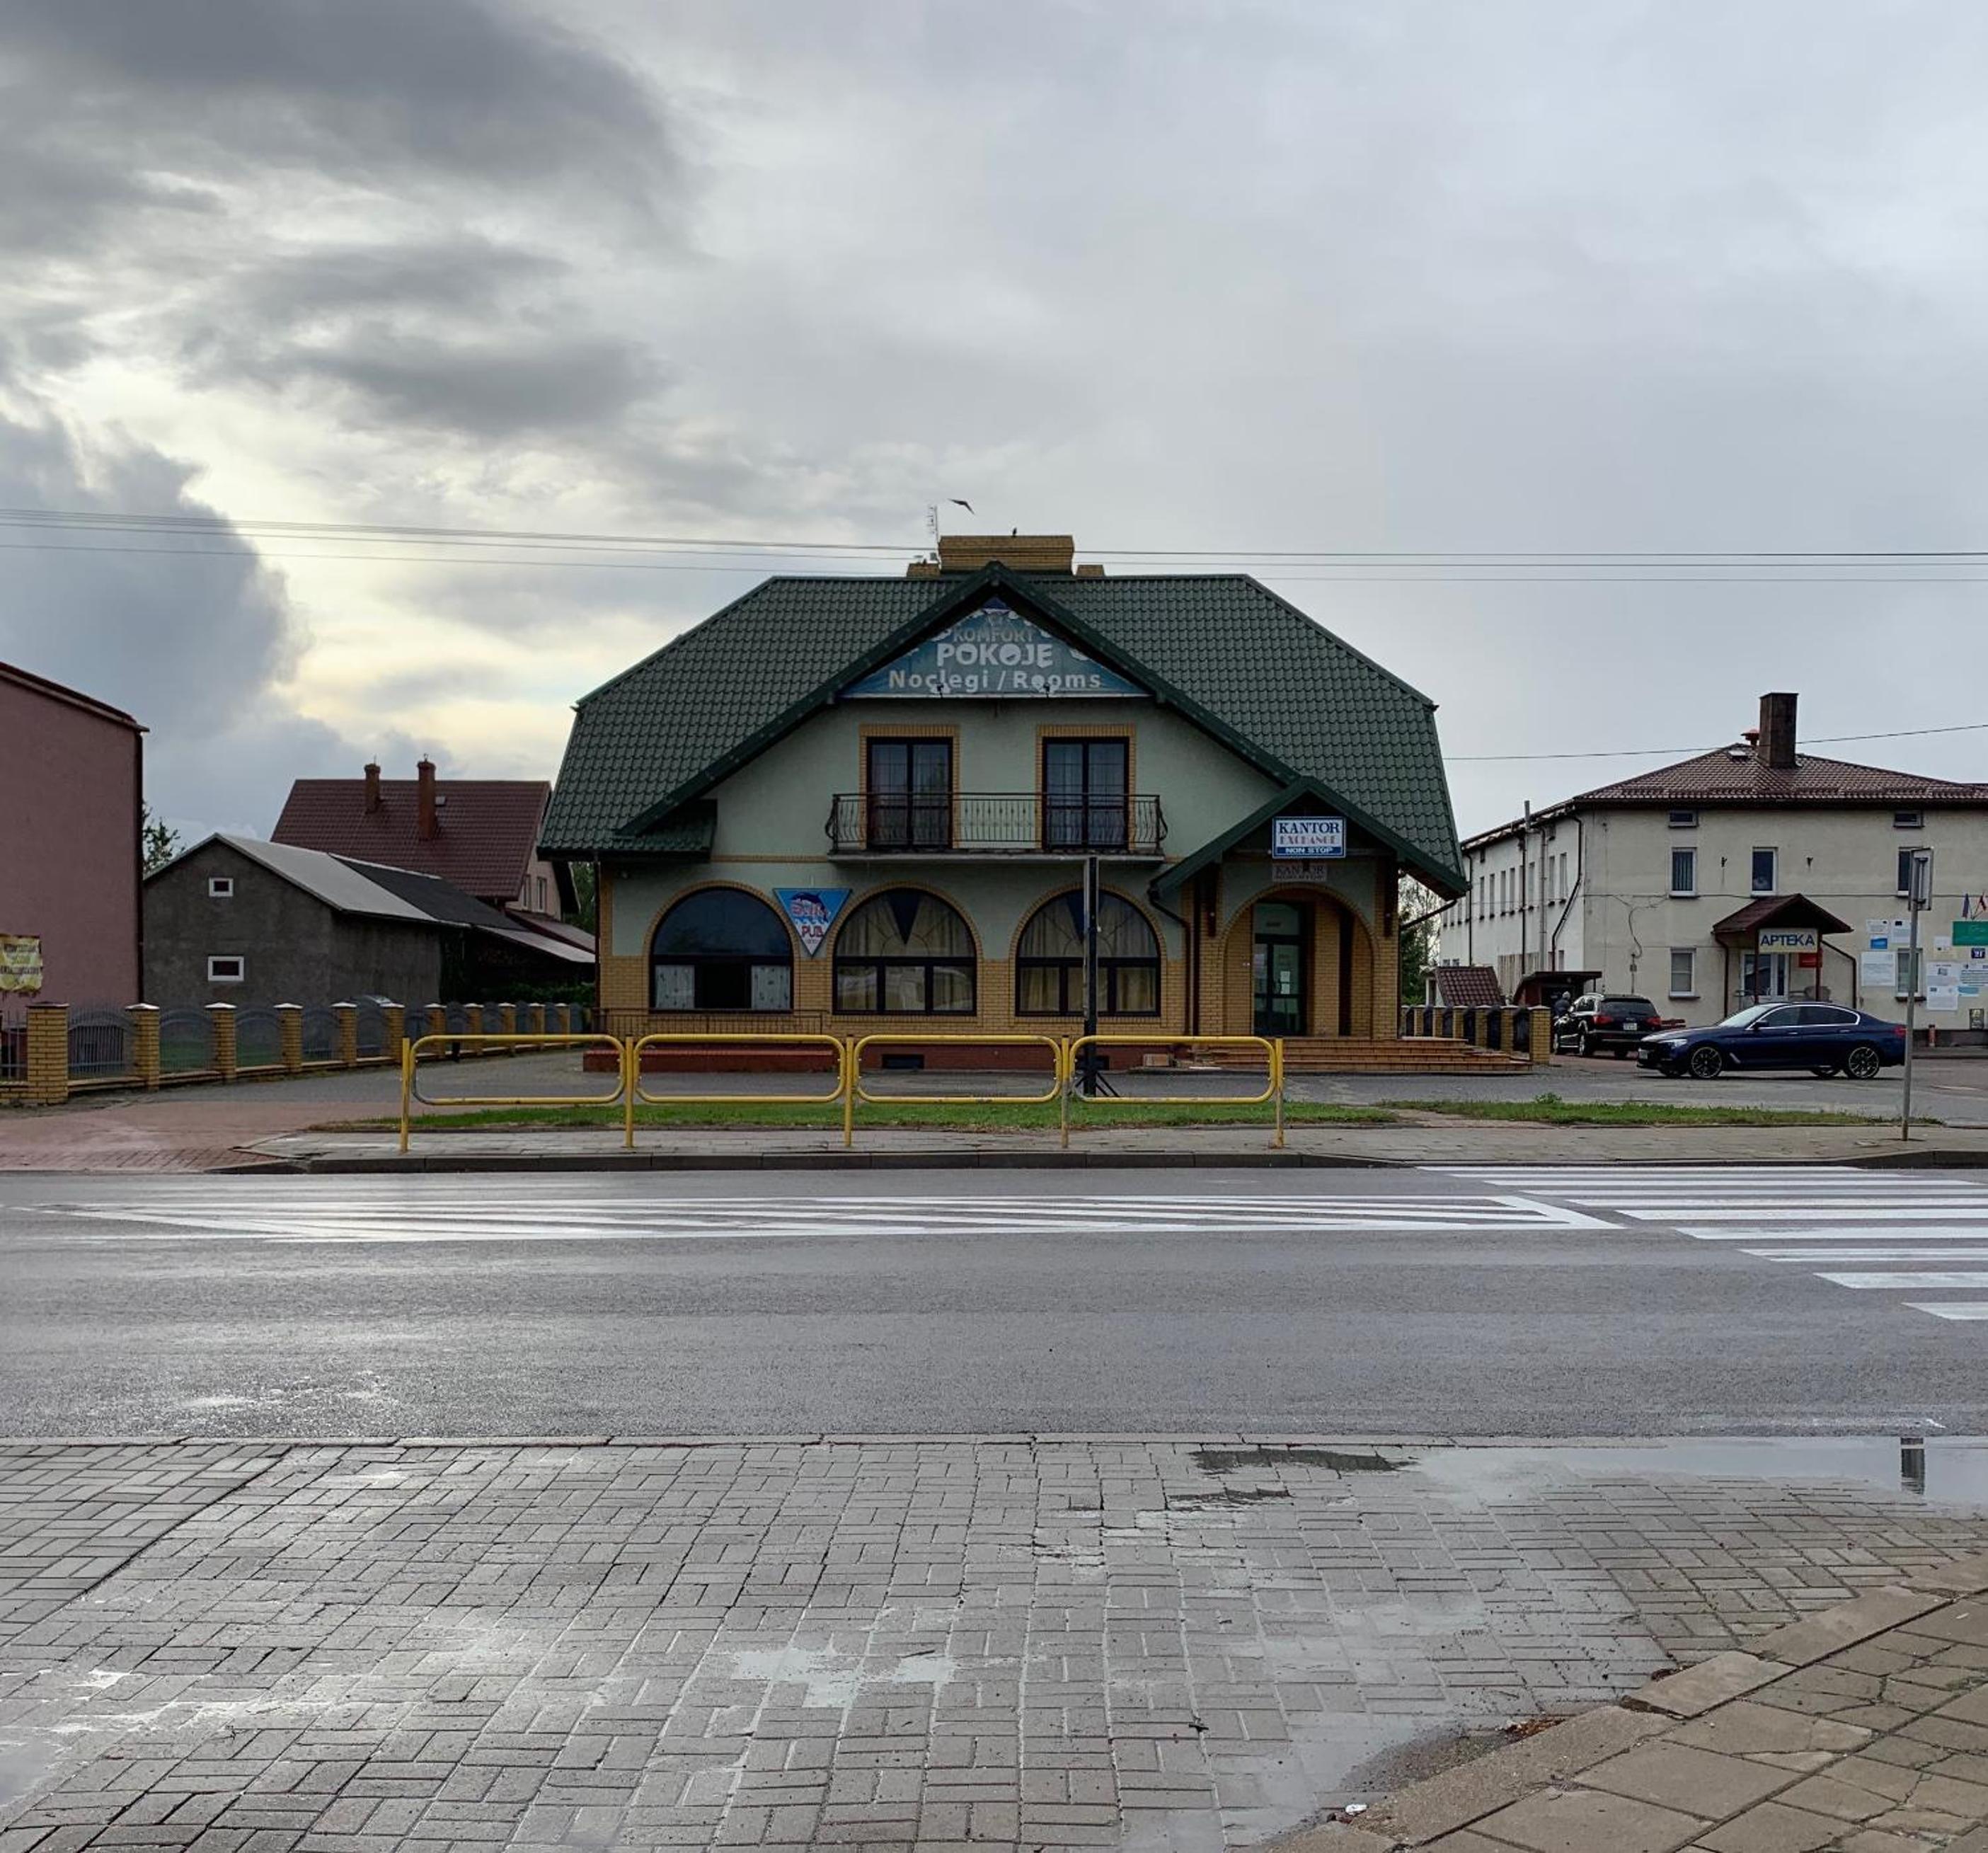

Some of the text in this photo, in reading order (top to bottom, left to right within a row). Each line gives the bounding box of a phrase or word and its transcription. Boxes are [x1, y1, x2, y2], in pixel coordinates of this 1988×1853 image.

[936, 643, 1054, 668] POKOJE
[888, 669, 989, 692] Noclegi
[1013, 670, 1101, 689] Rooms
[1279, 822, 1340, 834] KANTOR
[1275, 865, 1324, 875] KANOR
[801, 925, 824, 938] PUB
[1760, 934, 1815, 946] APTEKA
